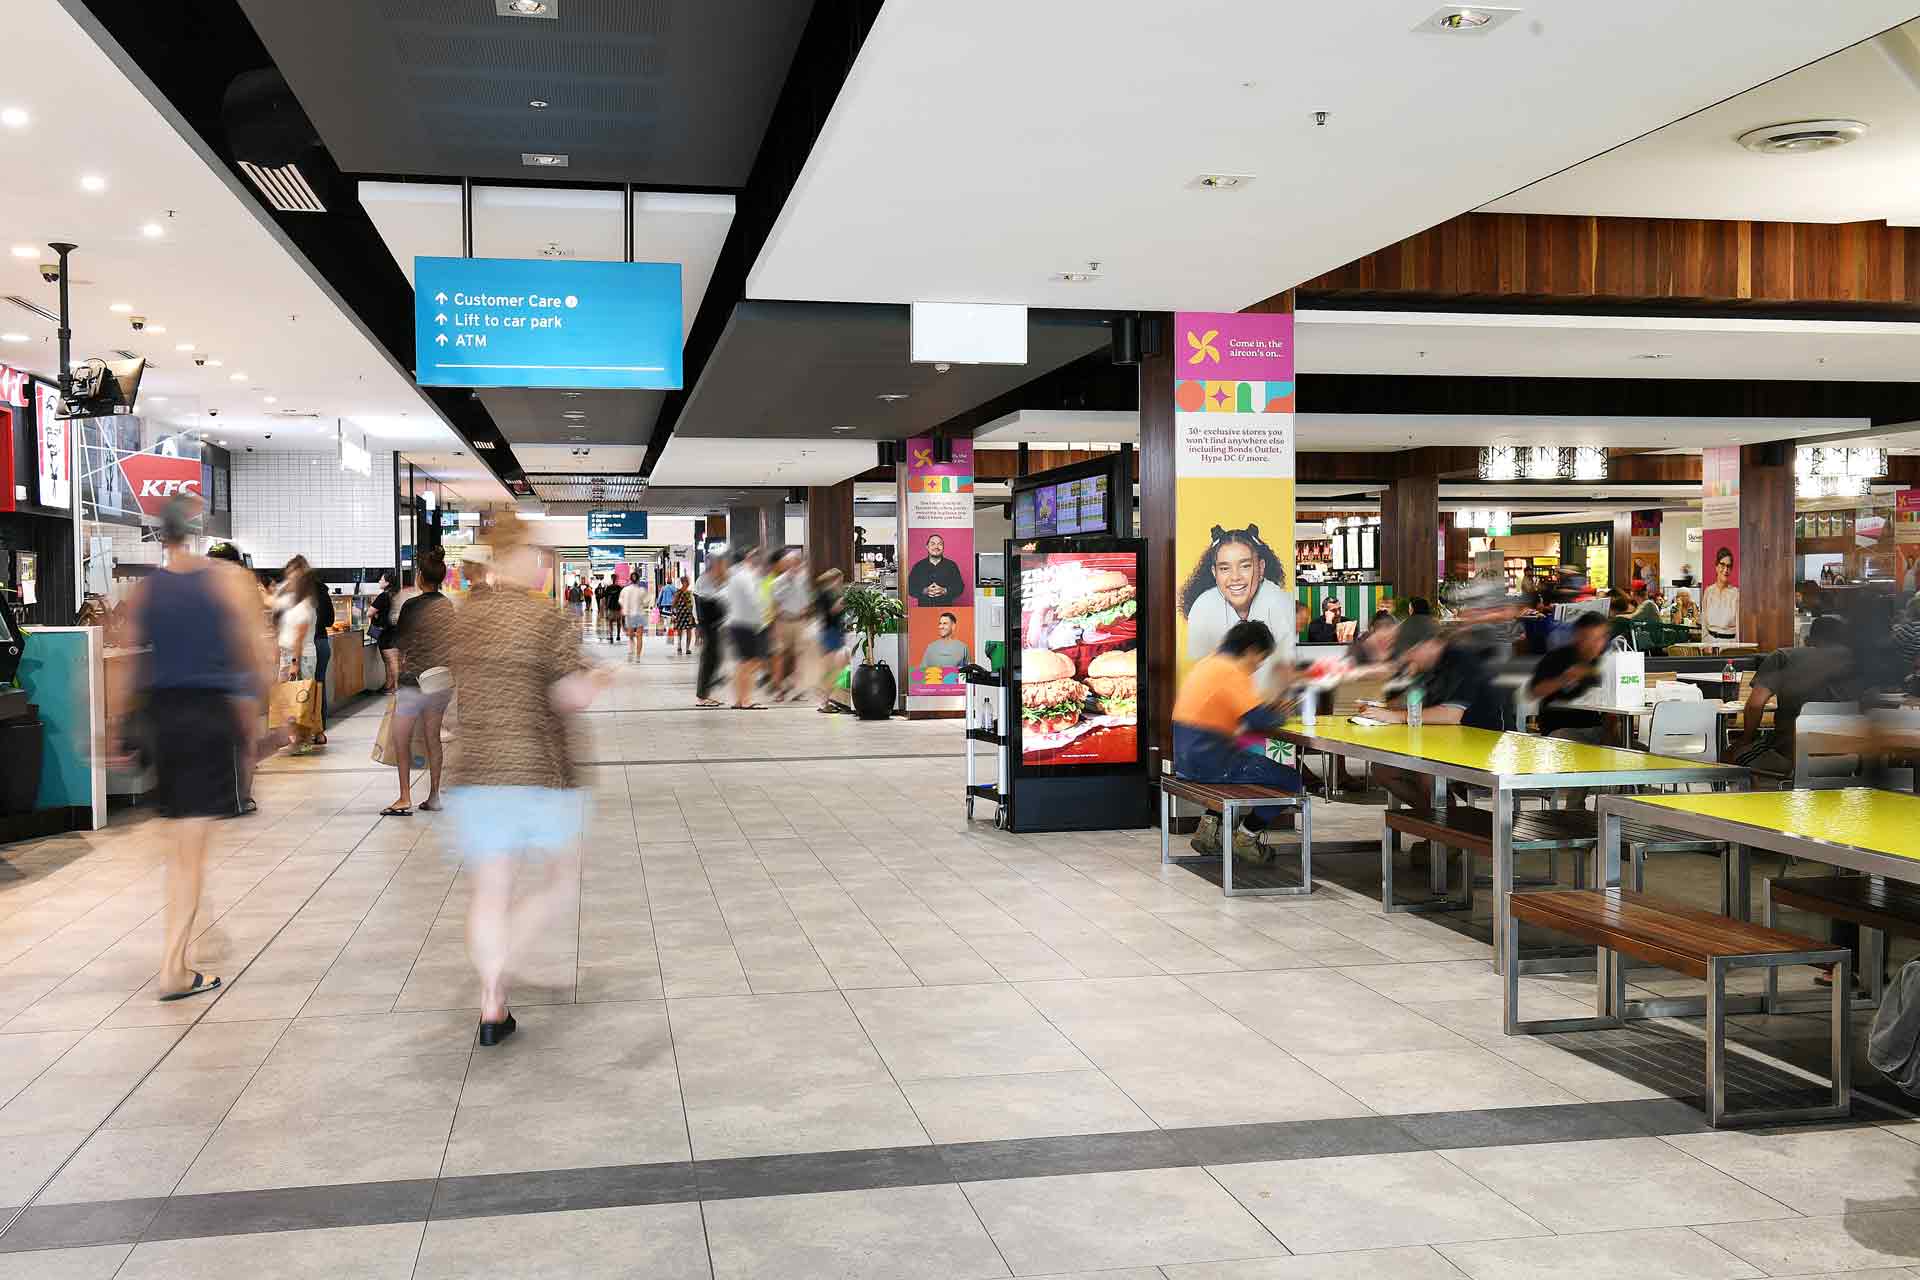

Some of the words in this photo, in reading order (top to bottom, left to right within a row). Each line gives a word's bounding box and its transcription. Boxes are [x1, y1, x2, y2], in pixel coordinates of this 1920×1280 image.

[454, 292, 525, 307] Customer
[528, 294, 562, 308] Care
[455, 313, 481, 327] Lift
[485, 314, 500, 327] to
[503, 317, 528, 328] car
[530, 315, 563, 330] park
[455, 334, 488, 348] ATM
[1230, 338, 1255, 347] Come
[1268, 340, 1283, 348] the
[1230, 348, 1265, 357] aircon's
[1203, 427, 1241, 436] exclusive
[1242, 428, 1267, 436] stores
[1268, 430, 1282, 438] you
[1209, 436, 1226, 444] find
[1227, 437, 1268, 447] anywhere
[1268, 437, 1285, 445] else
[1189, 445, 1227, 454] including
[1254, 446, 1282, 455] Outlet,
[1201, 454, 1223, 464] Hype
[1224, 454, 1236, 462] DC
[139, 479, 201, 497] KFC
